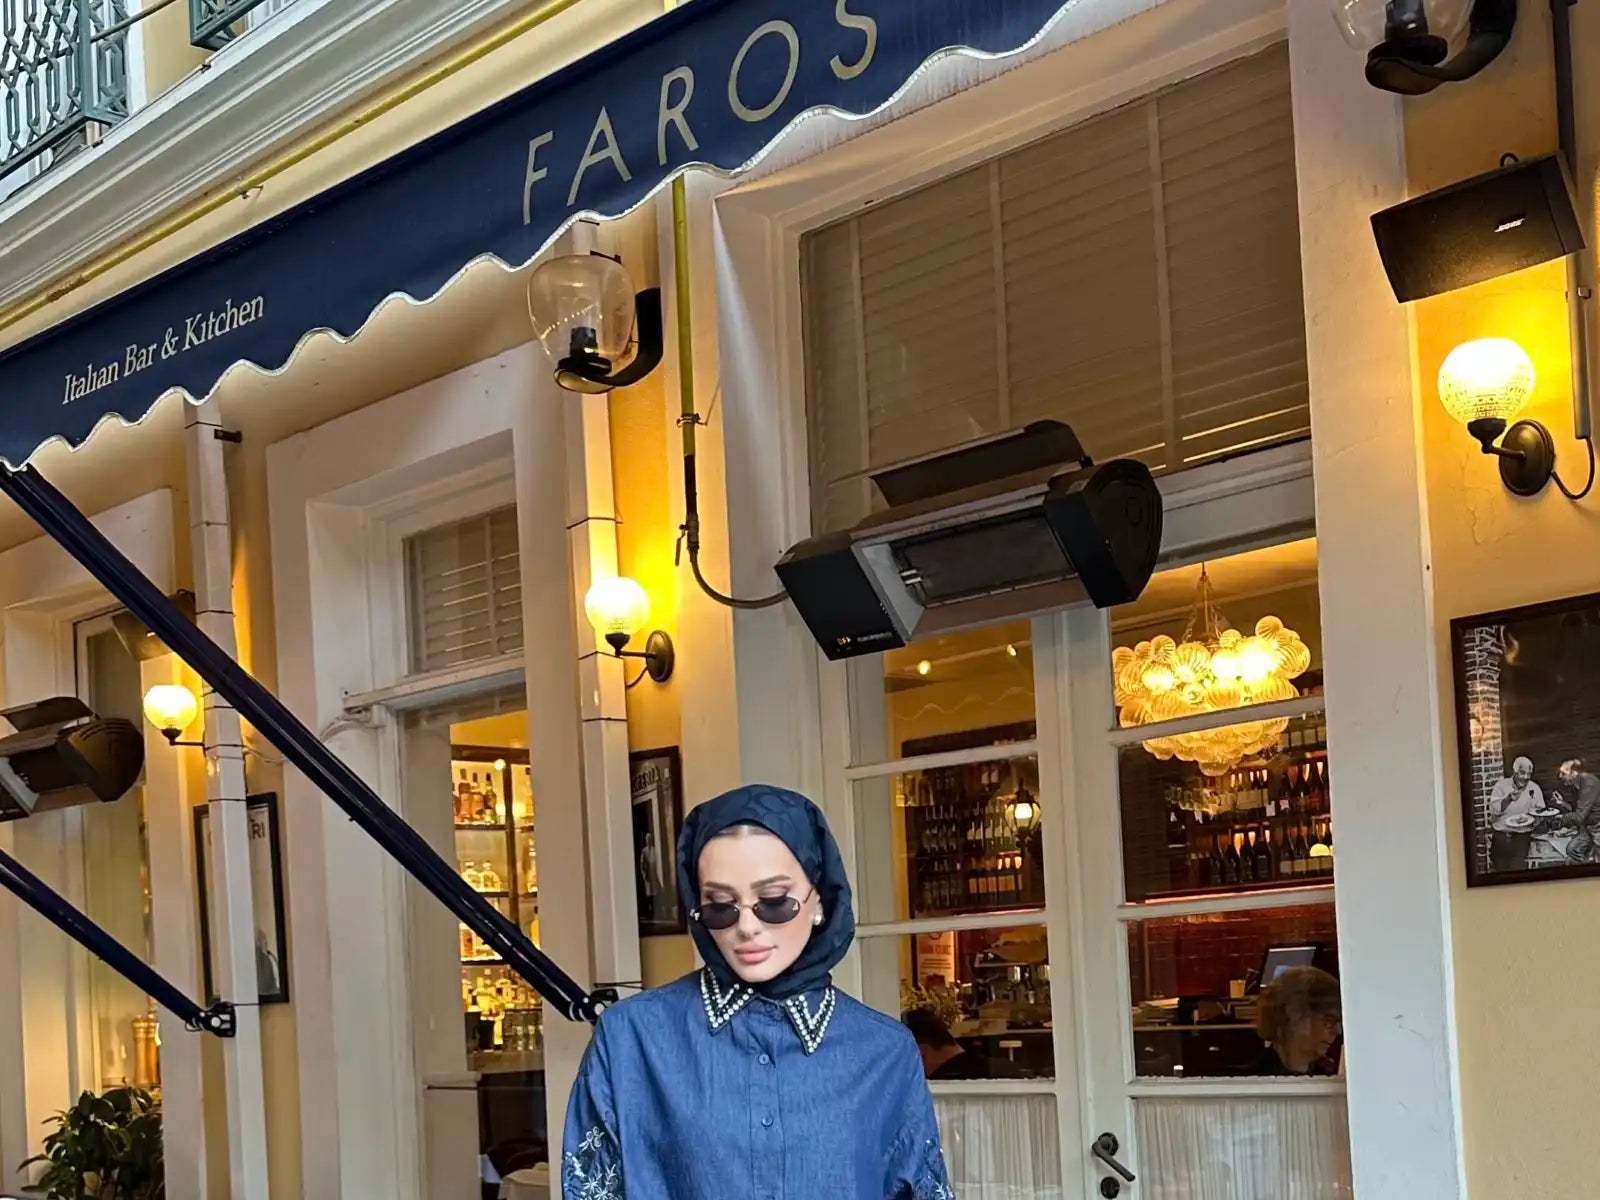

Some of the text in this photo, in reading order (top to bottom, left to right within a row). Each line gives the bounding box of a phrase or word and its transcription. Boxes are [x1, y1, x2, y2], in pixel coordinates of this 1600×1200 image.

[523, 0, 878, 225] FAROS
[62, 294, 264, 405] Italian Bar & Kitchen
